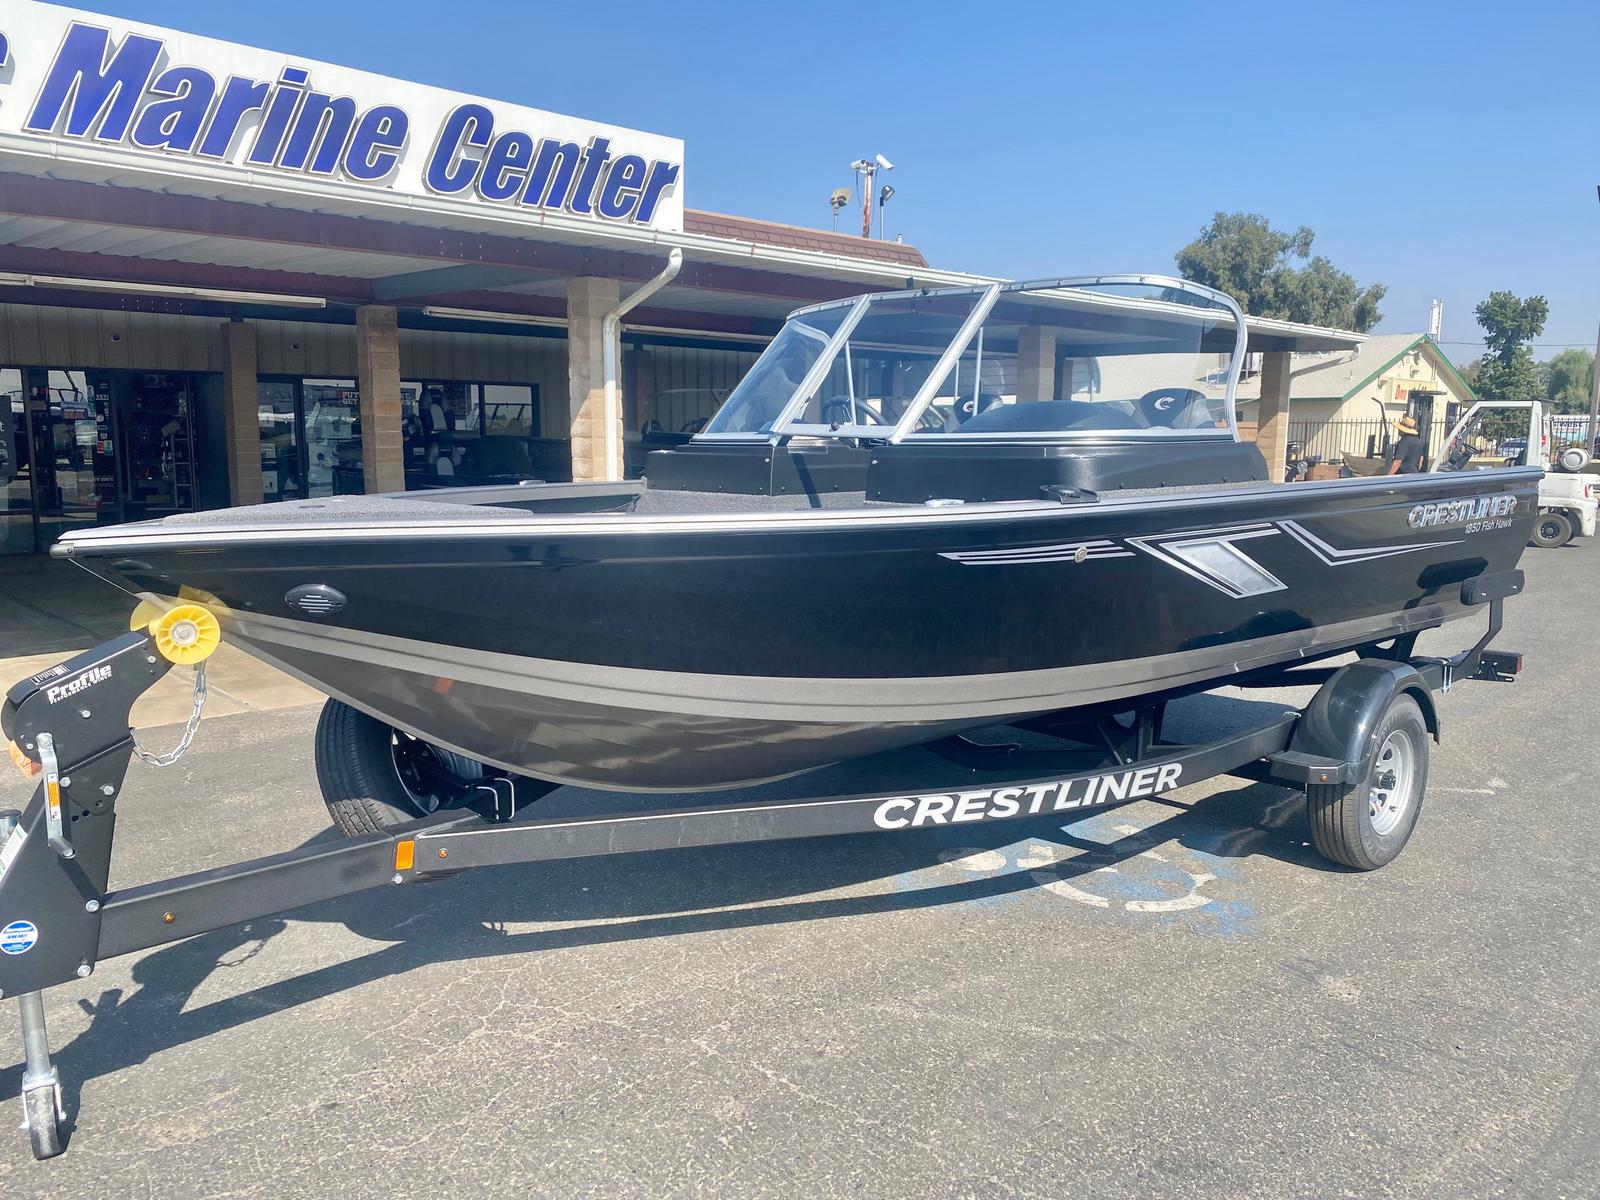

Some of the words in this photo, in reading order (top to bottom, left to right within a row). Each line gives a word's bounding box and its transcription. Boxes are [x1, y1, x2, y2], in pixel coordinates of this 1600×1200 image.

[22, 20, 410, 182] Marine
[424, 103, 681, 225] Center
[1407, 494, 1518, 529] CRESTLINER
[1464, 521, 1481, 534] 1850
[1481, 519, 1496, 531] Fish
[1496, 517, 1513, 529] Hawk
[46, 664, 112, 702] Profile
[873, 762, 1184, 830] CRESTLINER
